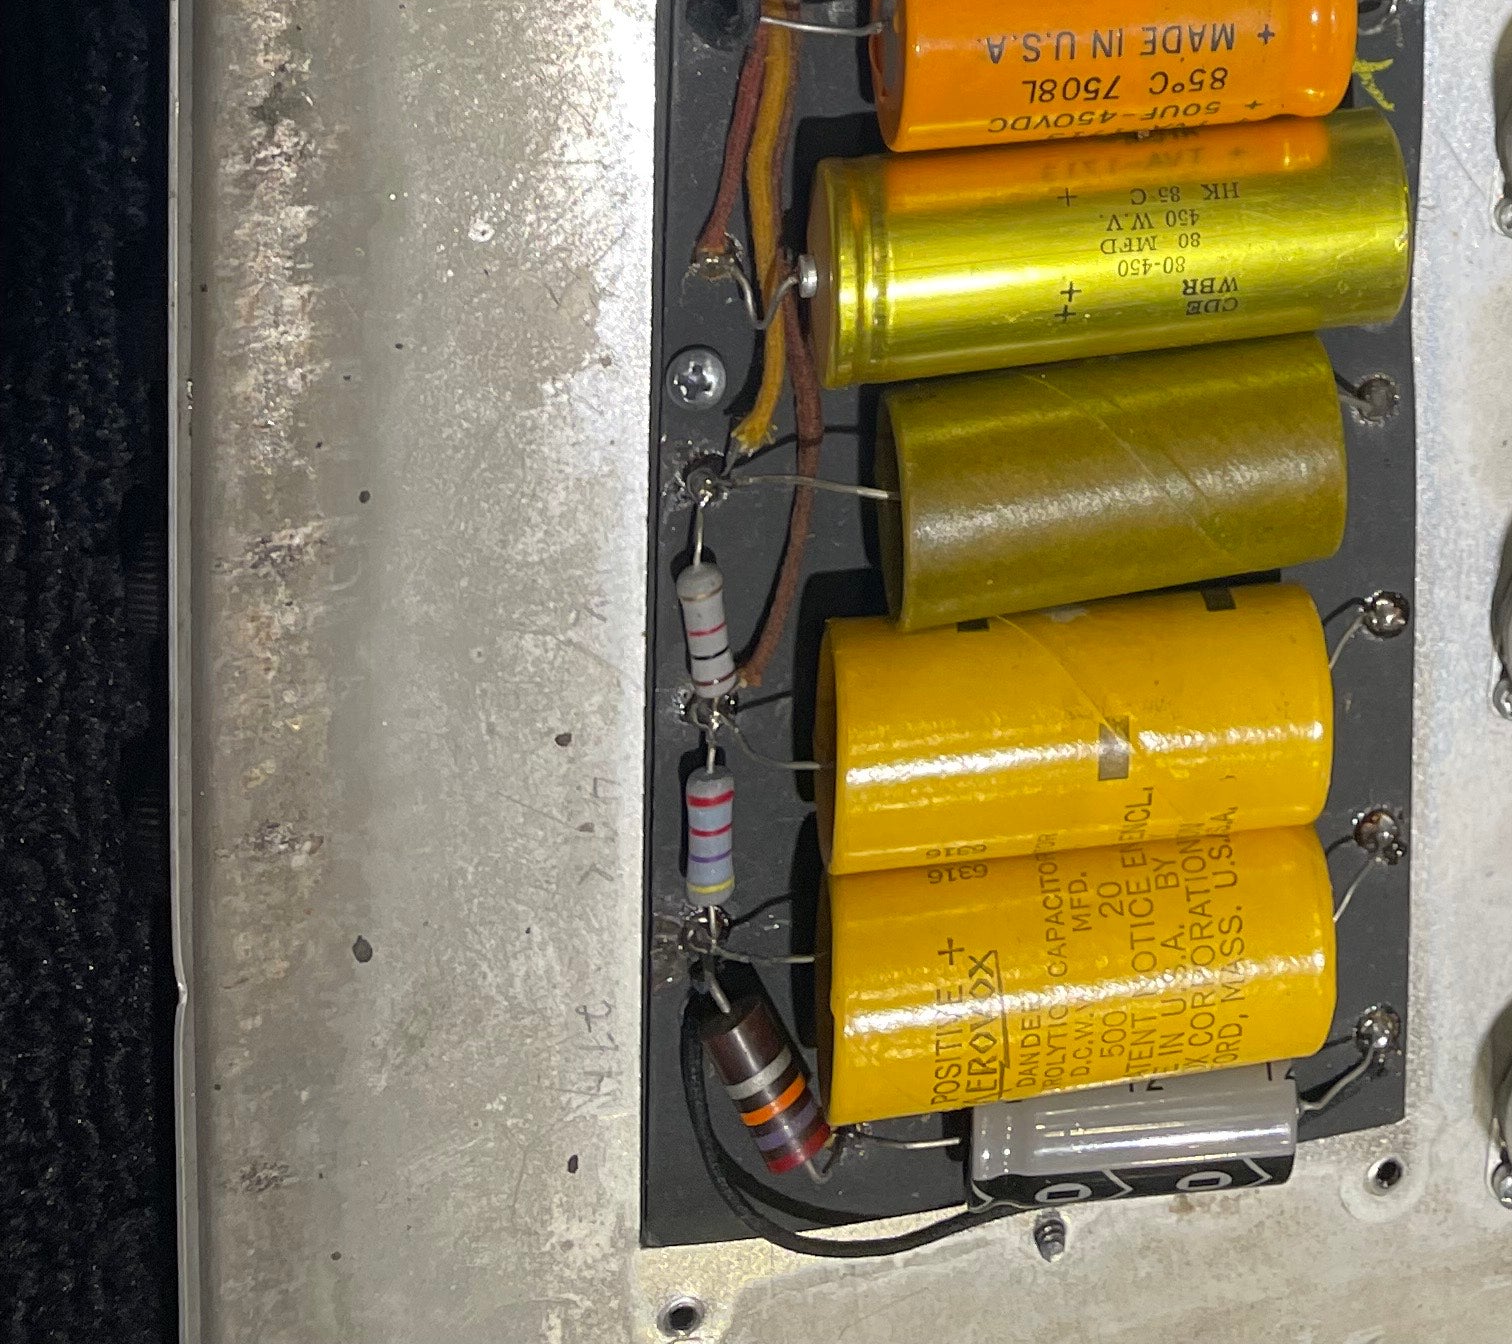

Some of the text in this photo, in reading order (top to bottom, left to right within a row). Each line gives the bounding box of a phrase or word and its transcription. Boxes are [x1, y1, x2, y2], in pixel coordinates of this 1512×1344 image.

[977, 22, 1235, 64] MADE IN U.S.A.
[1022, 74, 1122, 104] 7508L
[1129, 181, 1241, 206] HK 85 C
[1099, 208, 1201, 232] 450 W.V.
[1100, 231, 1202, 255] 80 MFD
[1117, 255, 1187, 278] 80-450
[1182, 276, 1240, 296] WBR
[1185, 296, 1239, 317] CDE
[926, 863, 989, 885] 6316
[1153, 857, 1180, 891] BY
[1035, 849, 1068, 978] CAPACITOR
[1068, 870, 1093, 933] MFD.
[1126, 874, 1158, 998] OTICE
[1097, 881, 1128, 1059] 500 20
[1159, 924, 1190, 1018] U..A.
[1126, 1011, 1158, 1078] ATENT
[1158, 1031, 1184, 1057] IN
